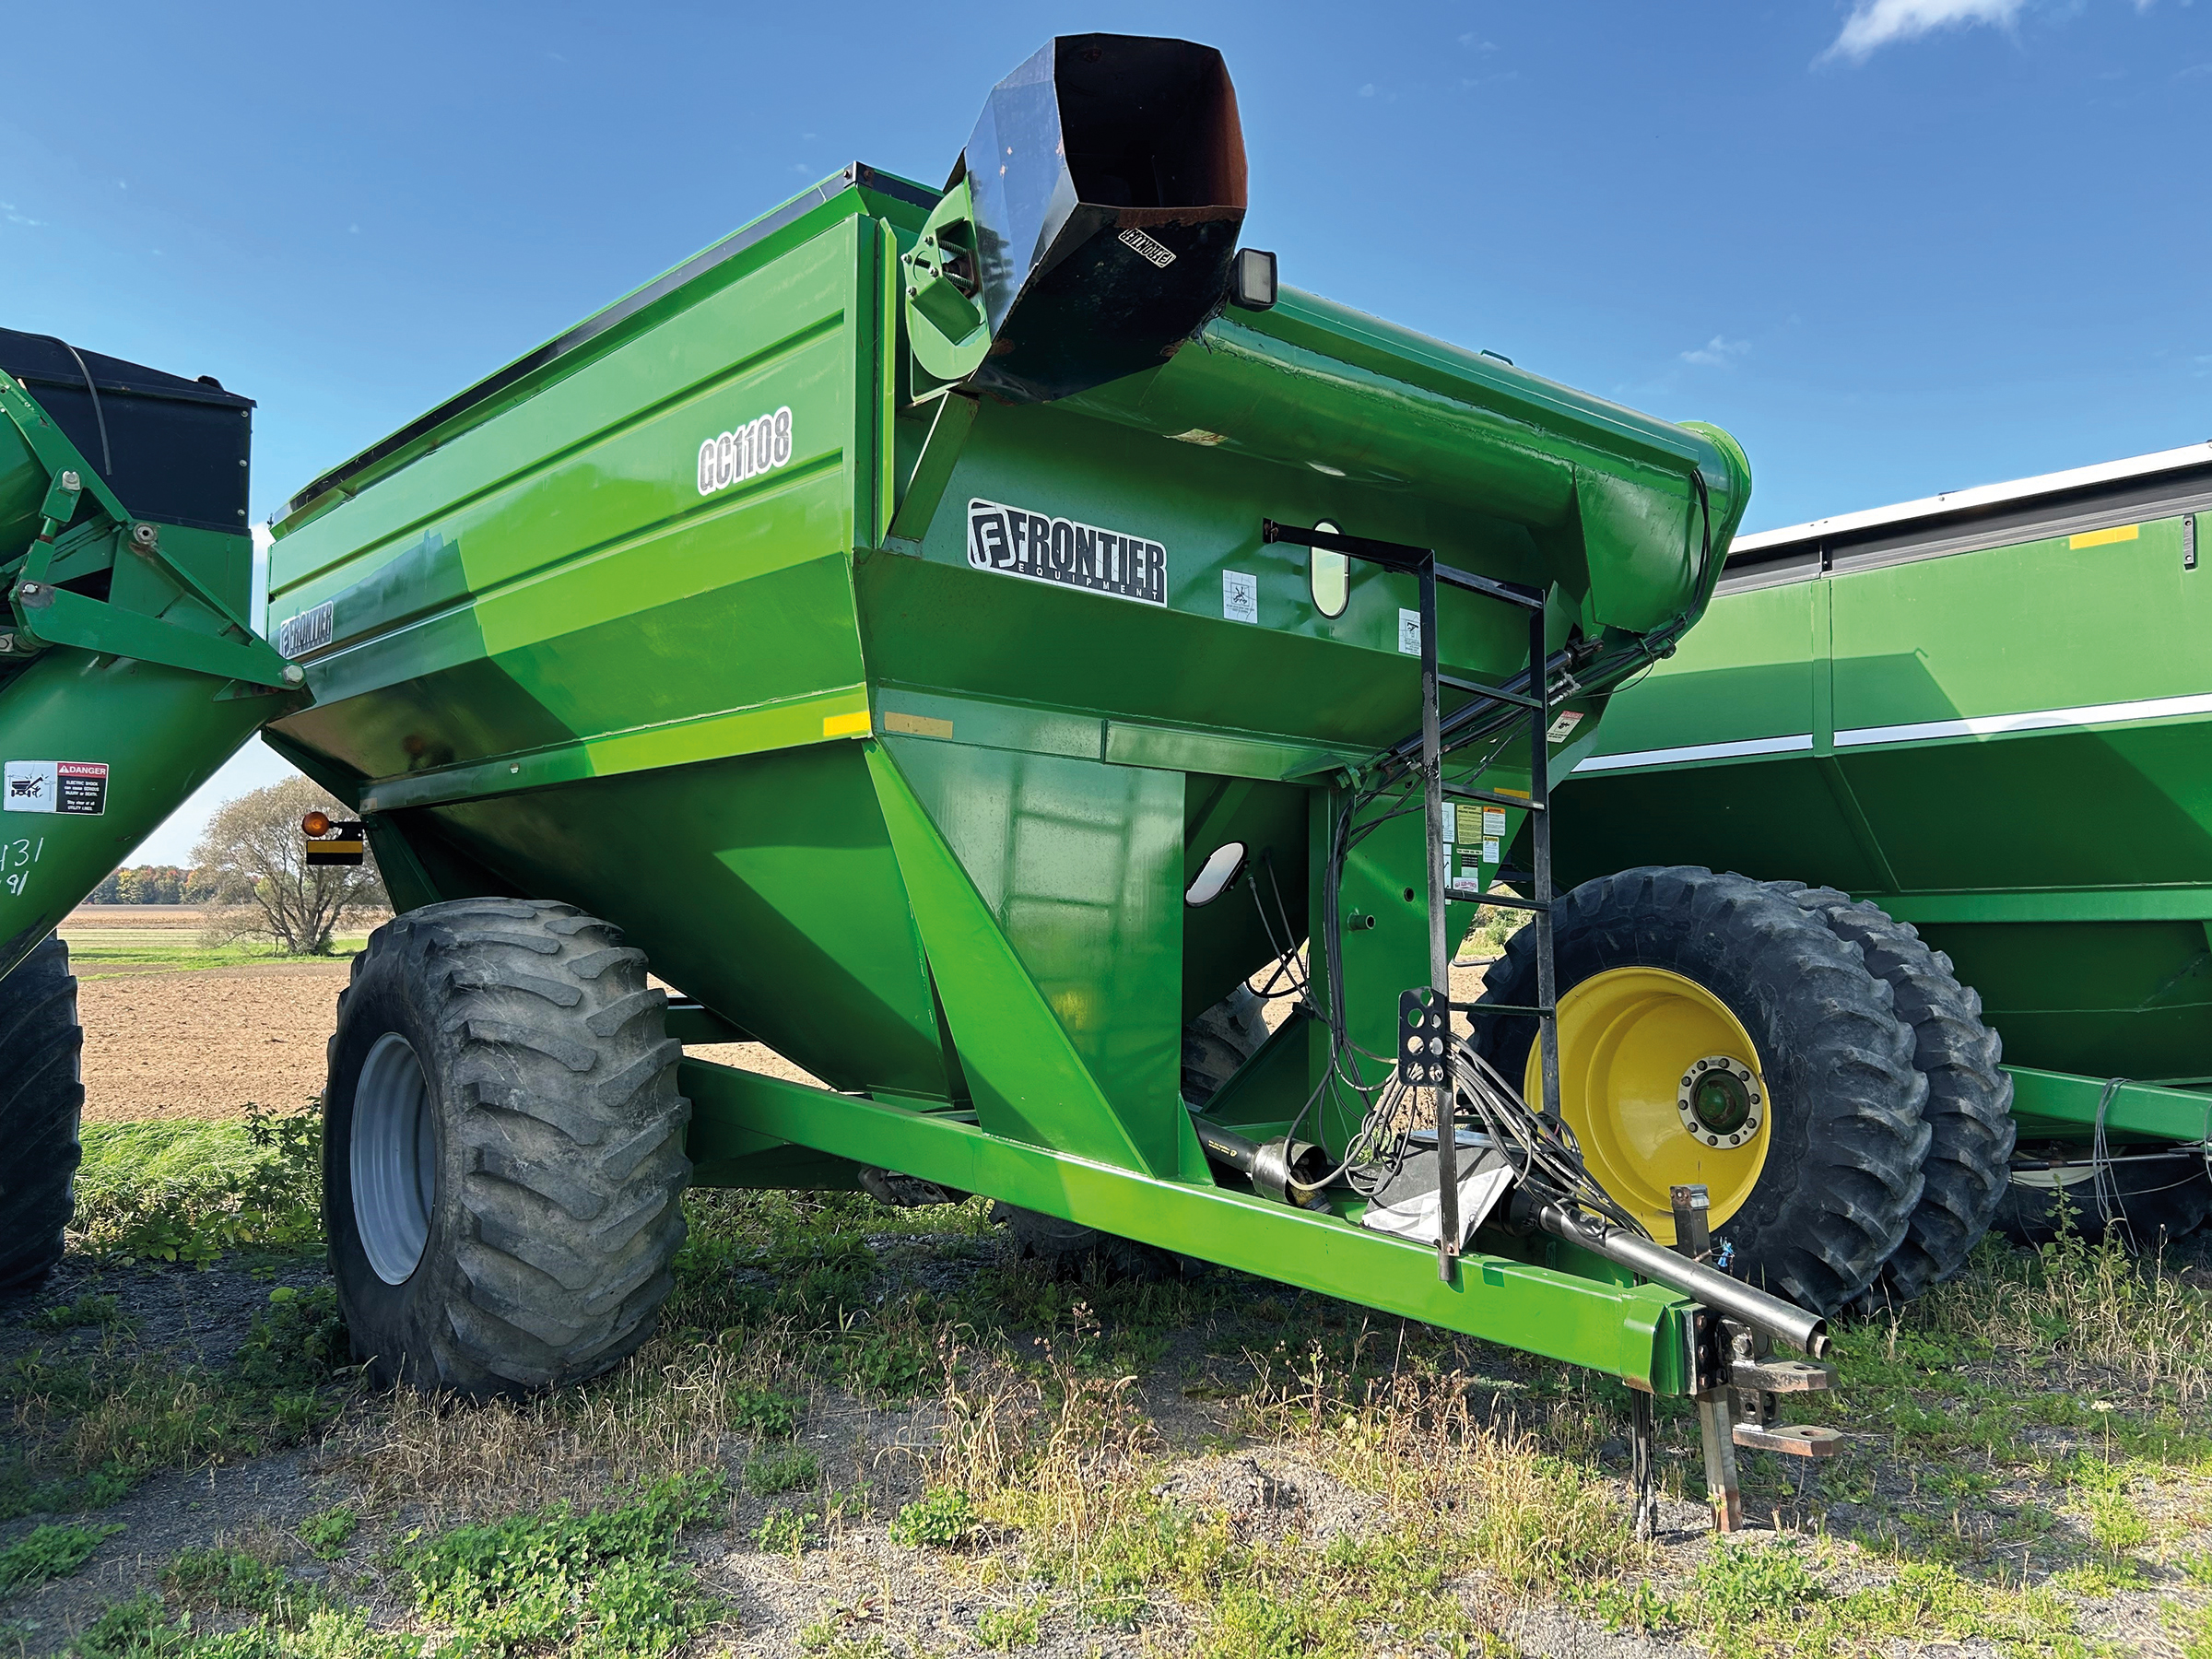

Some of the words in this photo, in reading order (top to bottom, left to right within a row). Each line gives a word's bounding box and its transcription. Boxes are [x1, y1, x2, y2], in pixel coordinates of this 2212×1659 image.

[699, 408, 791, 493] GC1108
[1008, 509, 1165, 594] FRONTIER
[1018, 562, 1158, 600] EQUIPMENT
[289, 604, 332, 649] FRONTIER
[69, 766, 106, 775] DANGER
